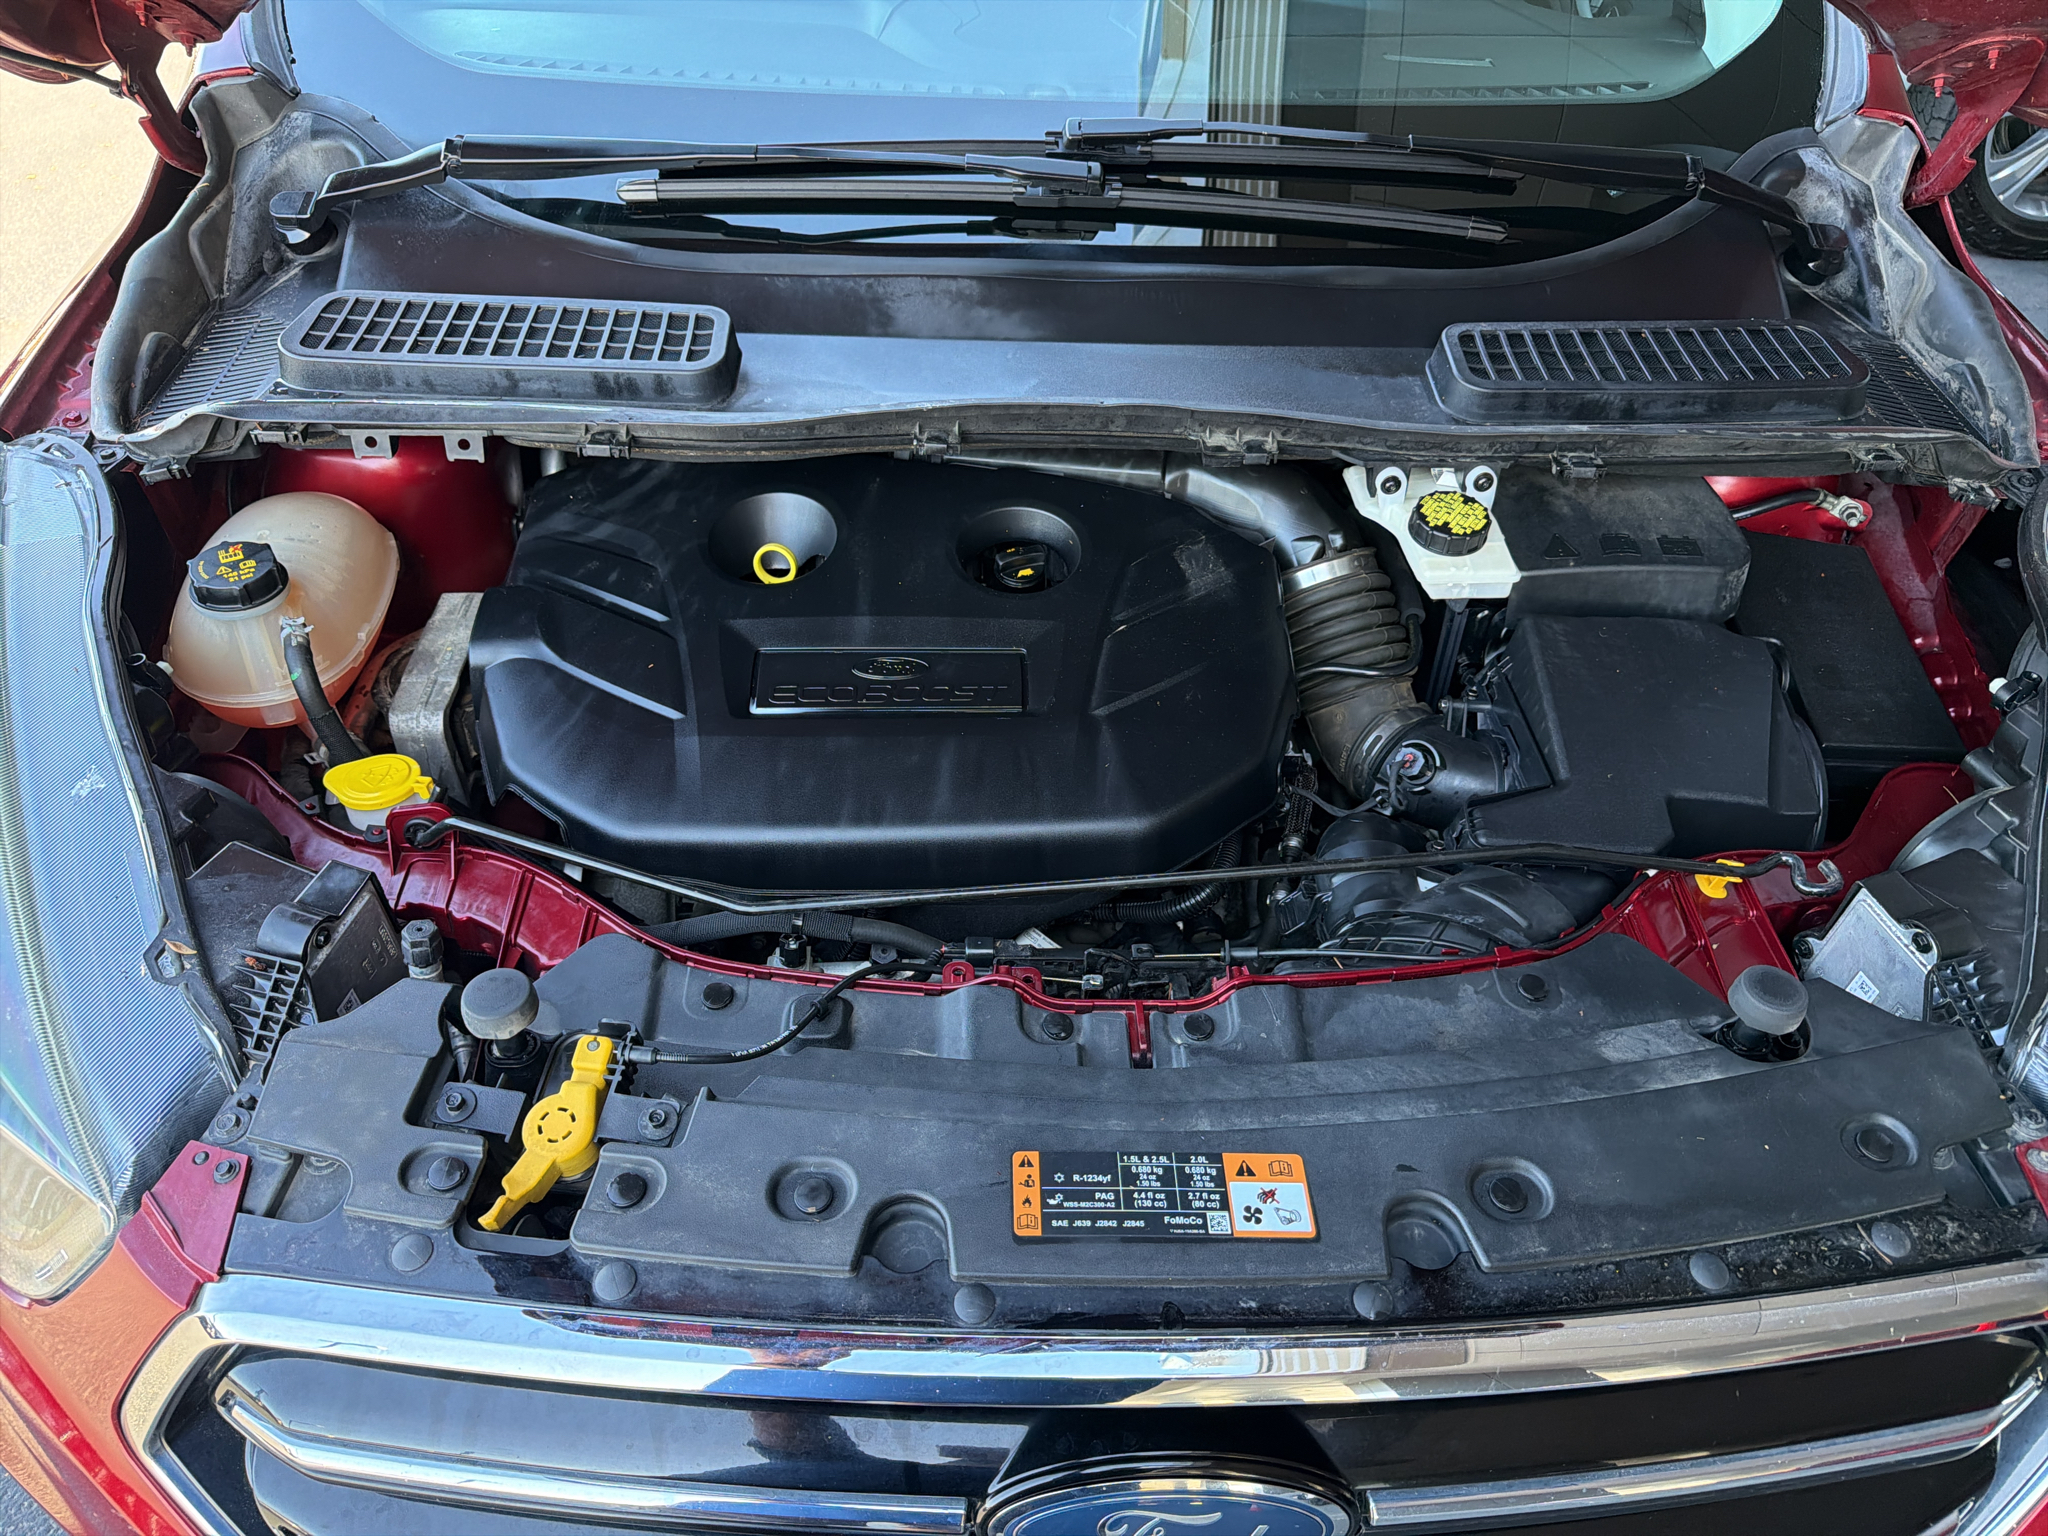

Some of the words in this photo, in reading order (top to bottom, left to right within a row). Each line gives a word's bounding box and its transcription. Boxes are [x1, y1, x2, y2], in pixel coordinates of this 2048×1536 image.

[1123, 1155, 1141, 1163] 1.5L
[1143, 1155, 1150, 1163] &
[1131, 1165, 1151, 1173] 0.680
[1153, 1165, 1163, 1175] kg
[1185, 1166, 1205, 1174] 0.680
[1207, 1167, 1216, 1176] kg
[1073, 1174, 1112, 1183] R-1234yf
[1095, 1192, 1115, 1200] PAG
[1132, 1192, 1146, 1200] 4.4
[1147, 1192, 1154, 1200] fl
[1187, 1192, 1201, 1200] 2.7
[1202, 1192, 1208, 1200] fl
[1134, 1200, 1152, 1208] (130
[1153, 1200, 1167, 1209] cc)
[1191, 1200, 1205, 1209] (80
[1206, 1201, 1220, 1209] cc)
[1122, 1220, 1145, 1228] J2845
[1164, 1216, 1203, 1225] FoMoCo
